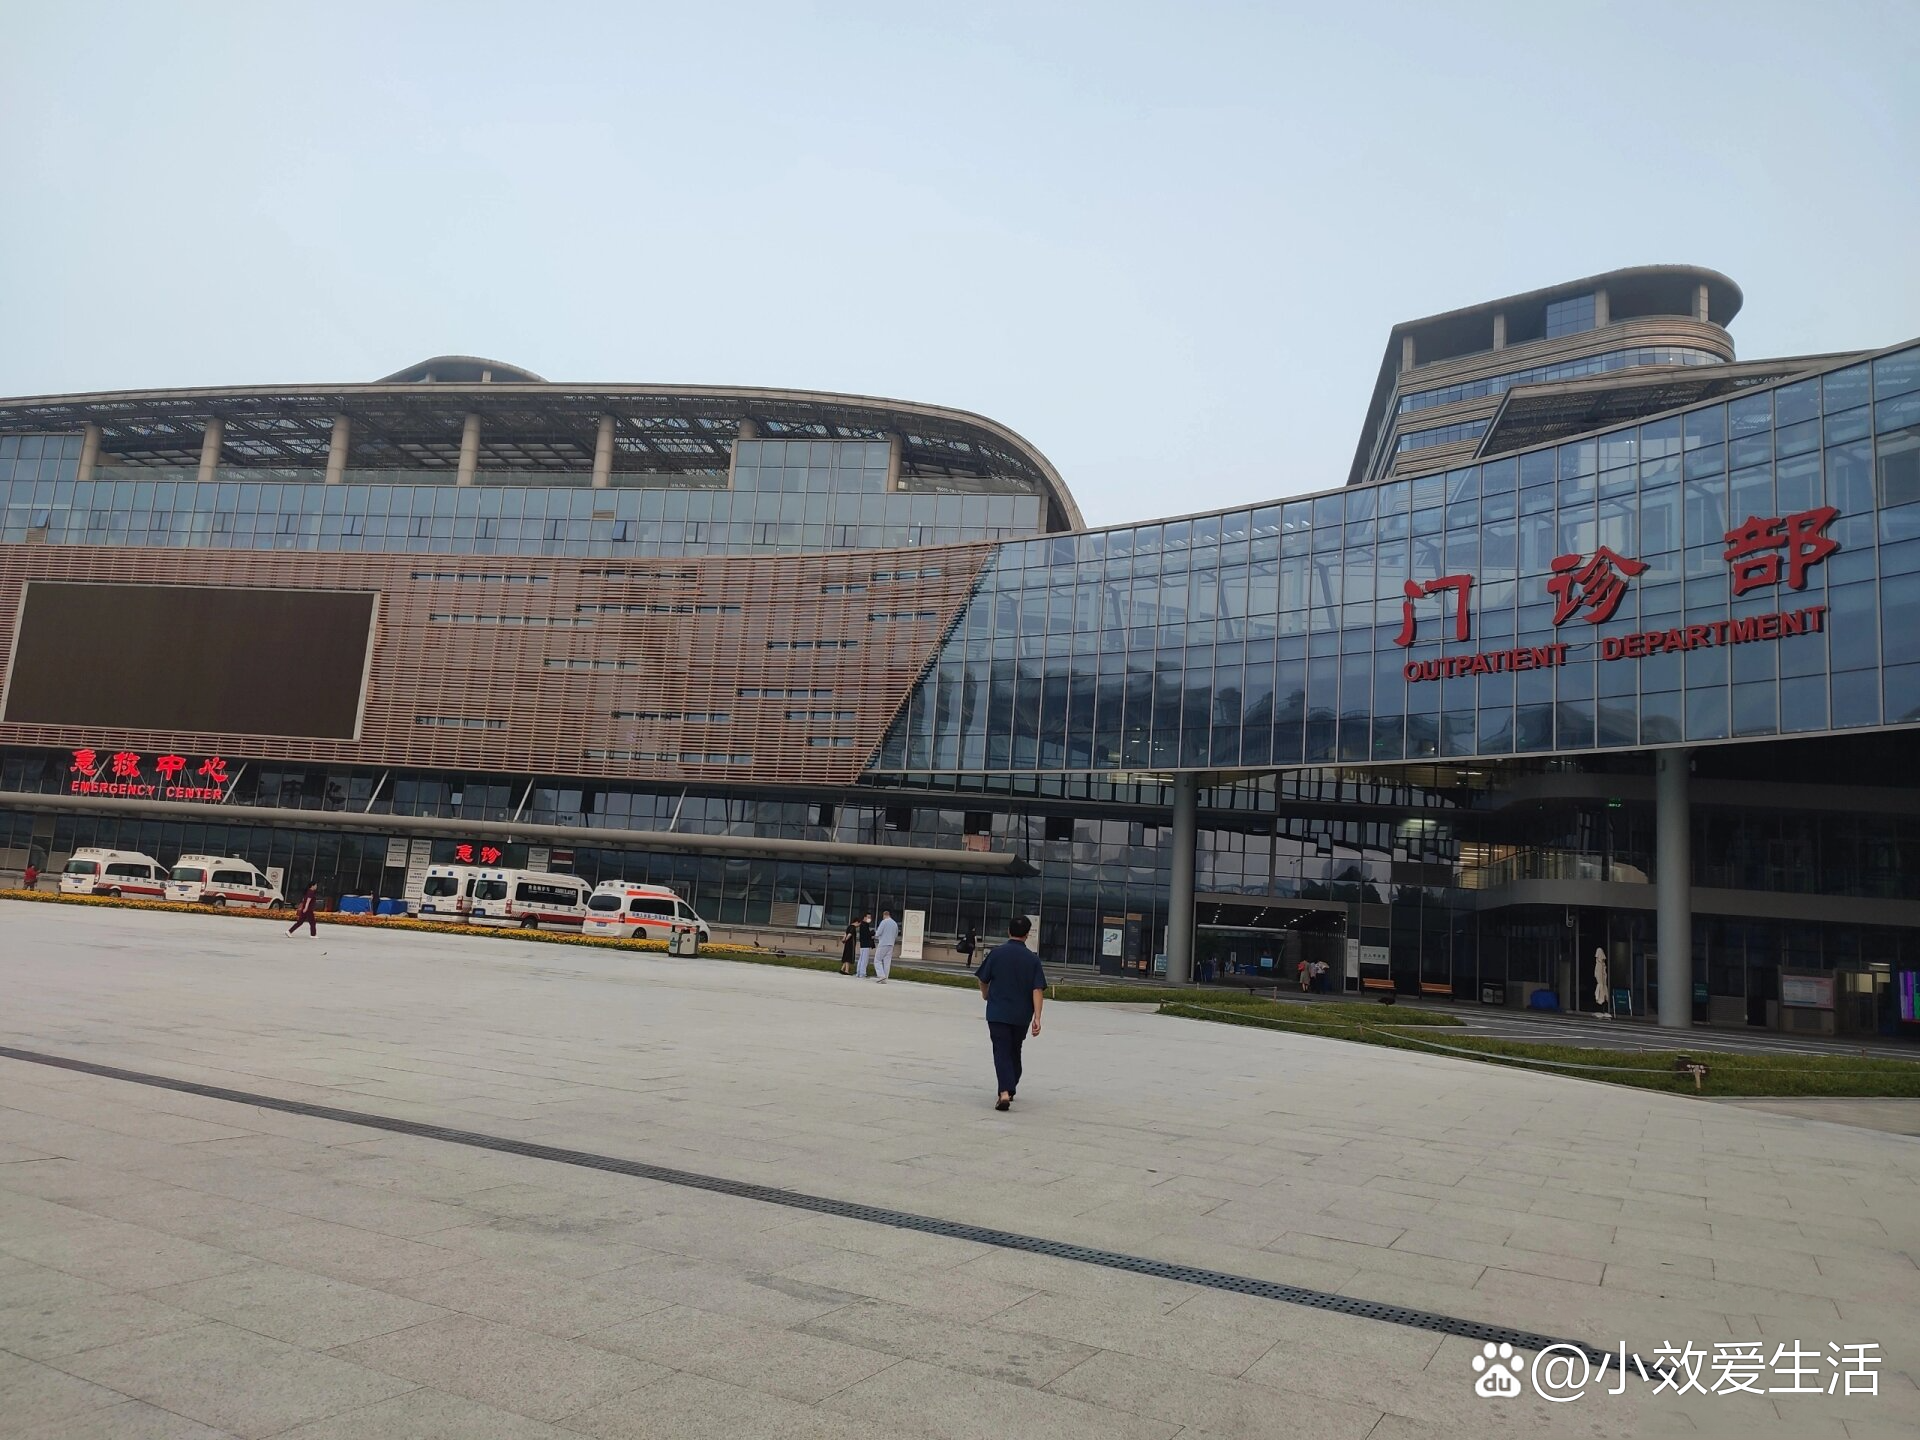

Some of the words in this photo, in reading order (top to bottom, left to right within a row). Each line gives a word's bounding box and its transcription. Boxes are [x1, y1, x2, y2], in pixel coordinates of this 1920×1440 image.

[1394, 506, 1839, 647] 门诊部
[1403, 643, 1568, 682] OUTPATIENT
[1602, 606, 1826, 662] DEPARTMENT
[70, 749, 228, 783] 急救中心
[71, 780, 155, 796] EMERGENCY
[166, 786, 222, 800] CENTER
[455, 844, 502, 864] 急诊
